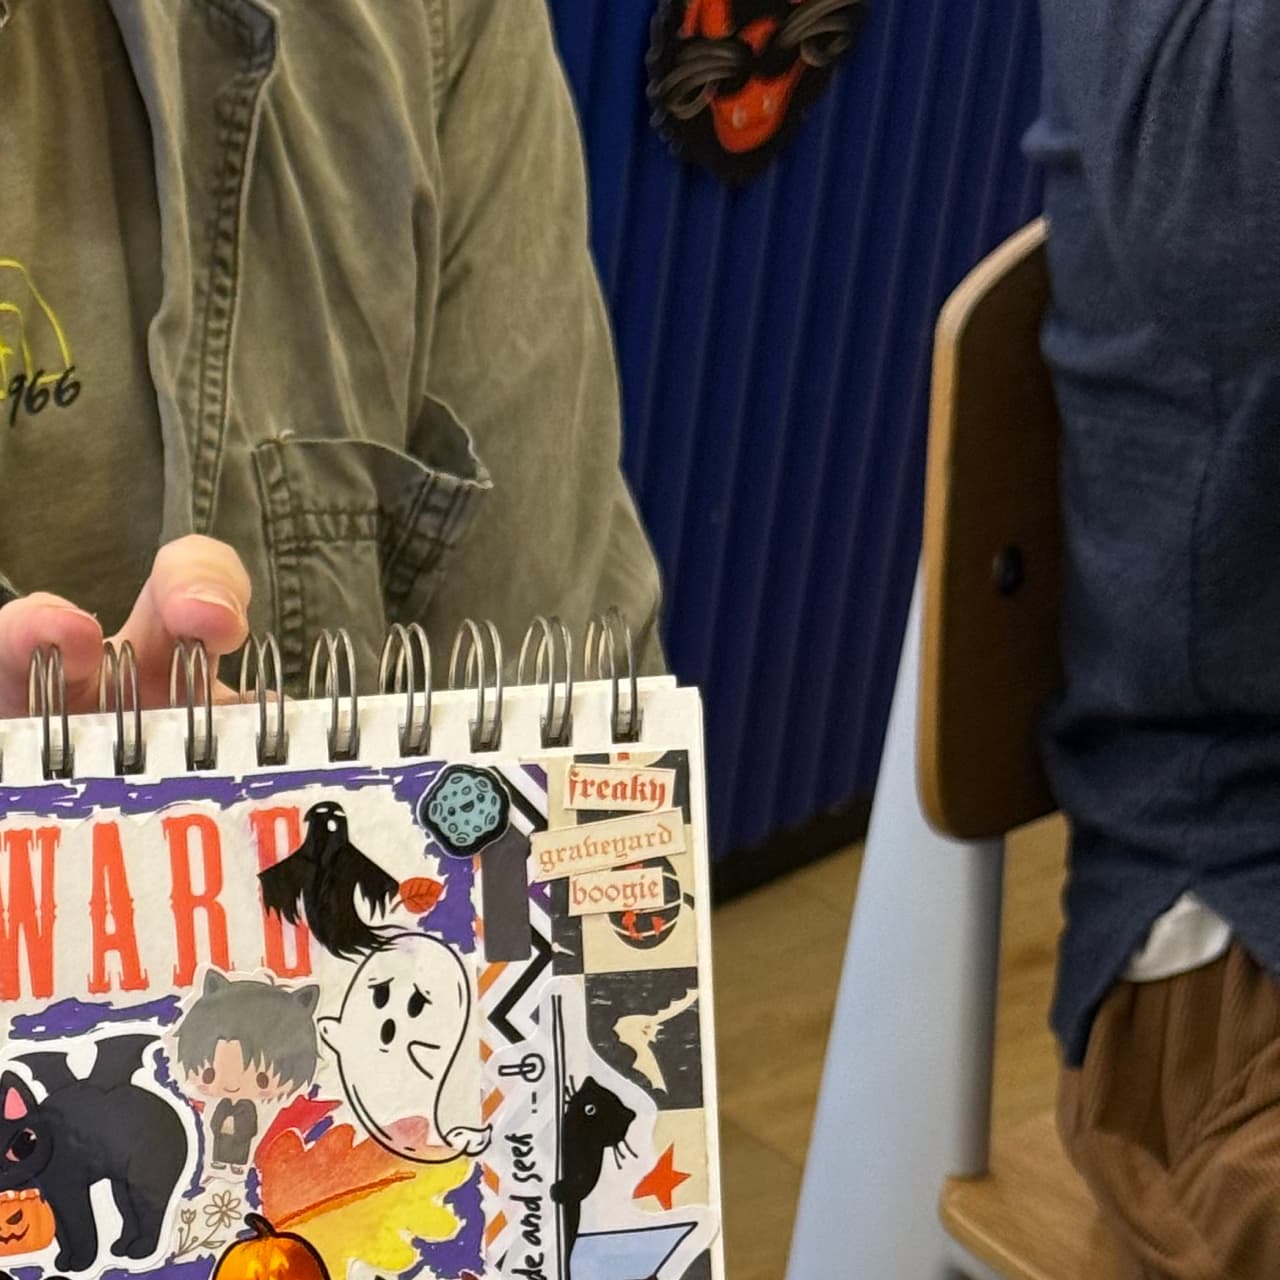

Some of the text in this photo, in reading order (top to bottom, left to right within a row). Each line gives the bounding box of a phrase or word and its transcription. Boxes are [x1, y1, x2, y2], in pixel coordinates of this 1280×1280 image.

[569, 770, 666, 810] freaky
[539, 823, 673, 873] graveyard
[571, 874, 659, 908] boogie
[503, 1132, 544, 1183] seek
[509, 1194, 544, 1246] and
